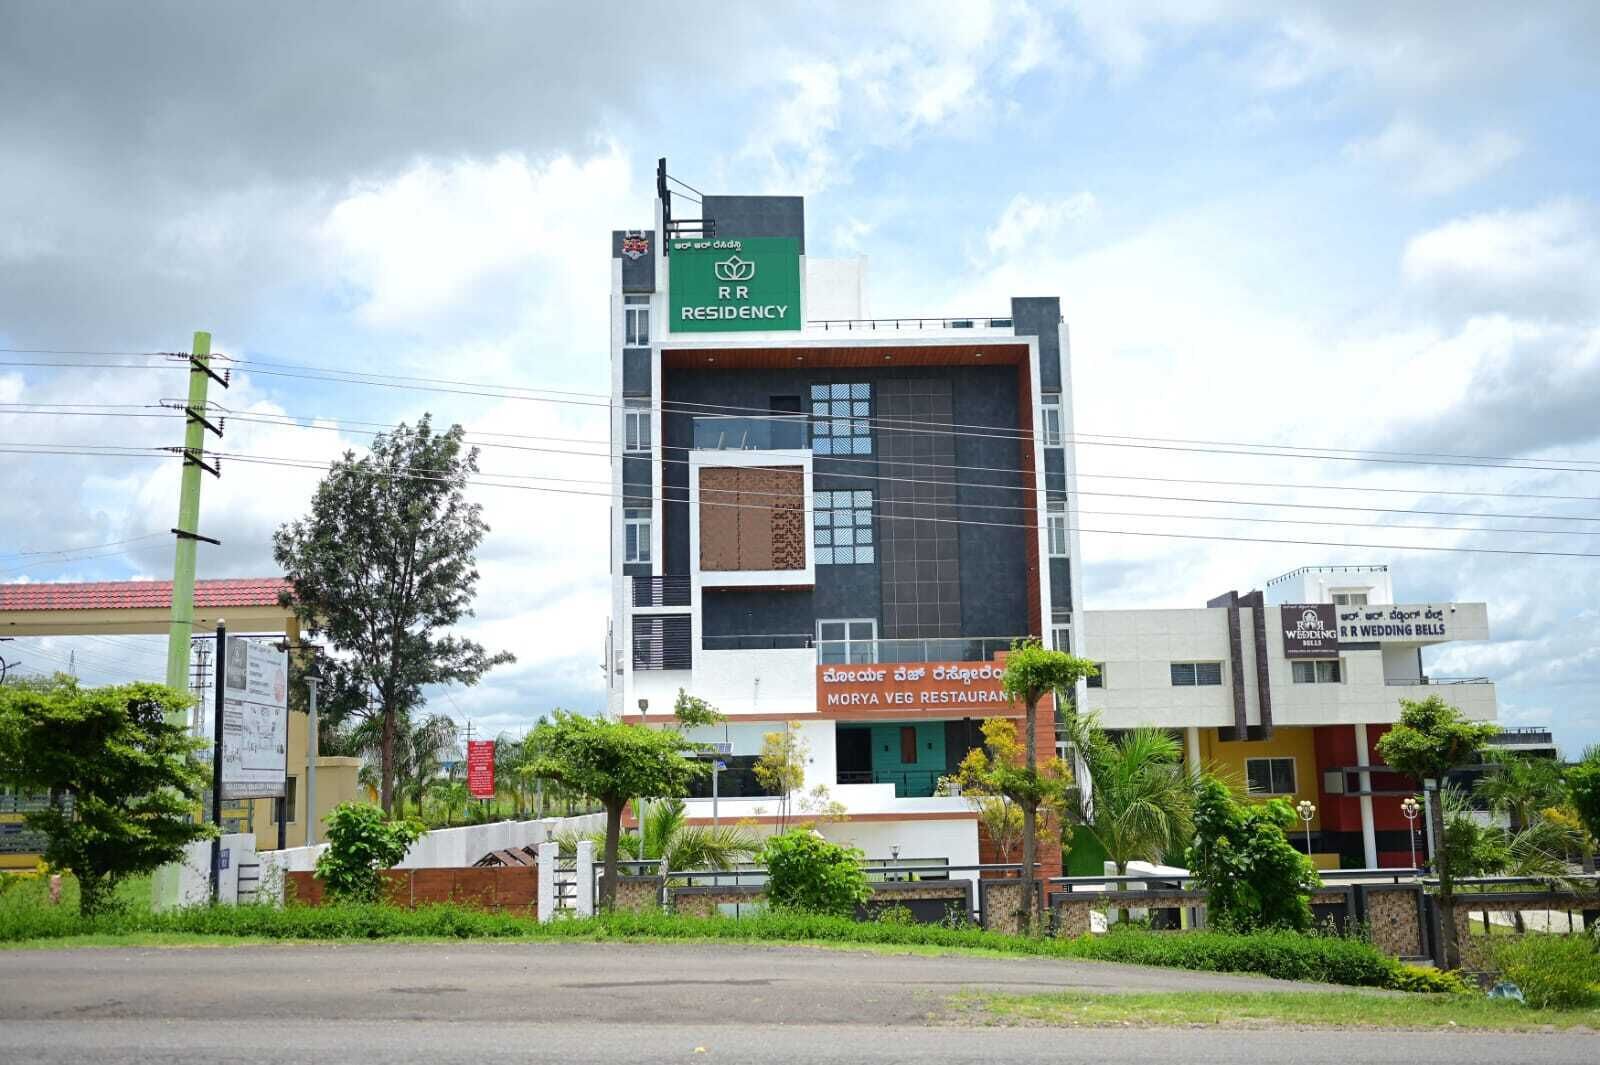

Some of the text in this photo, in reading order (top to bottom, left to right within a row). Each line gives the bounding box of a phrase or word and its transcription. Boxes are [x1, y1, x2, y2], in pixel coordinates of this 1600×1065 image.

[719, 286, 749, 299] R R
[681, 305, 788, 320] RESIDENCY
[1285, 630, 1337, 639] WEDDING
[1340, 623, 1446, 637] R R WEDDING BELLS
[894, 666, 926, 682] ವೆಜ್
[932, 665, 1004, 685] ರೆಸ್ಟೋರೆಂ
[827, 692, 880, 706] MORYA
[885, 691, 914, 704] VEG
